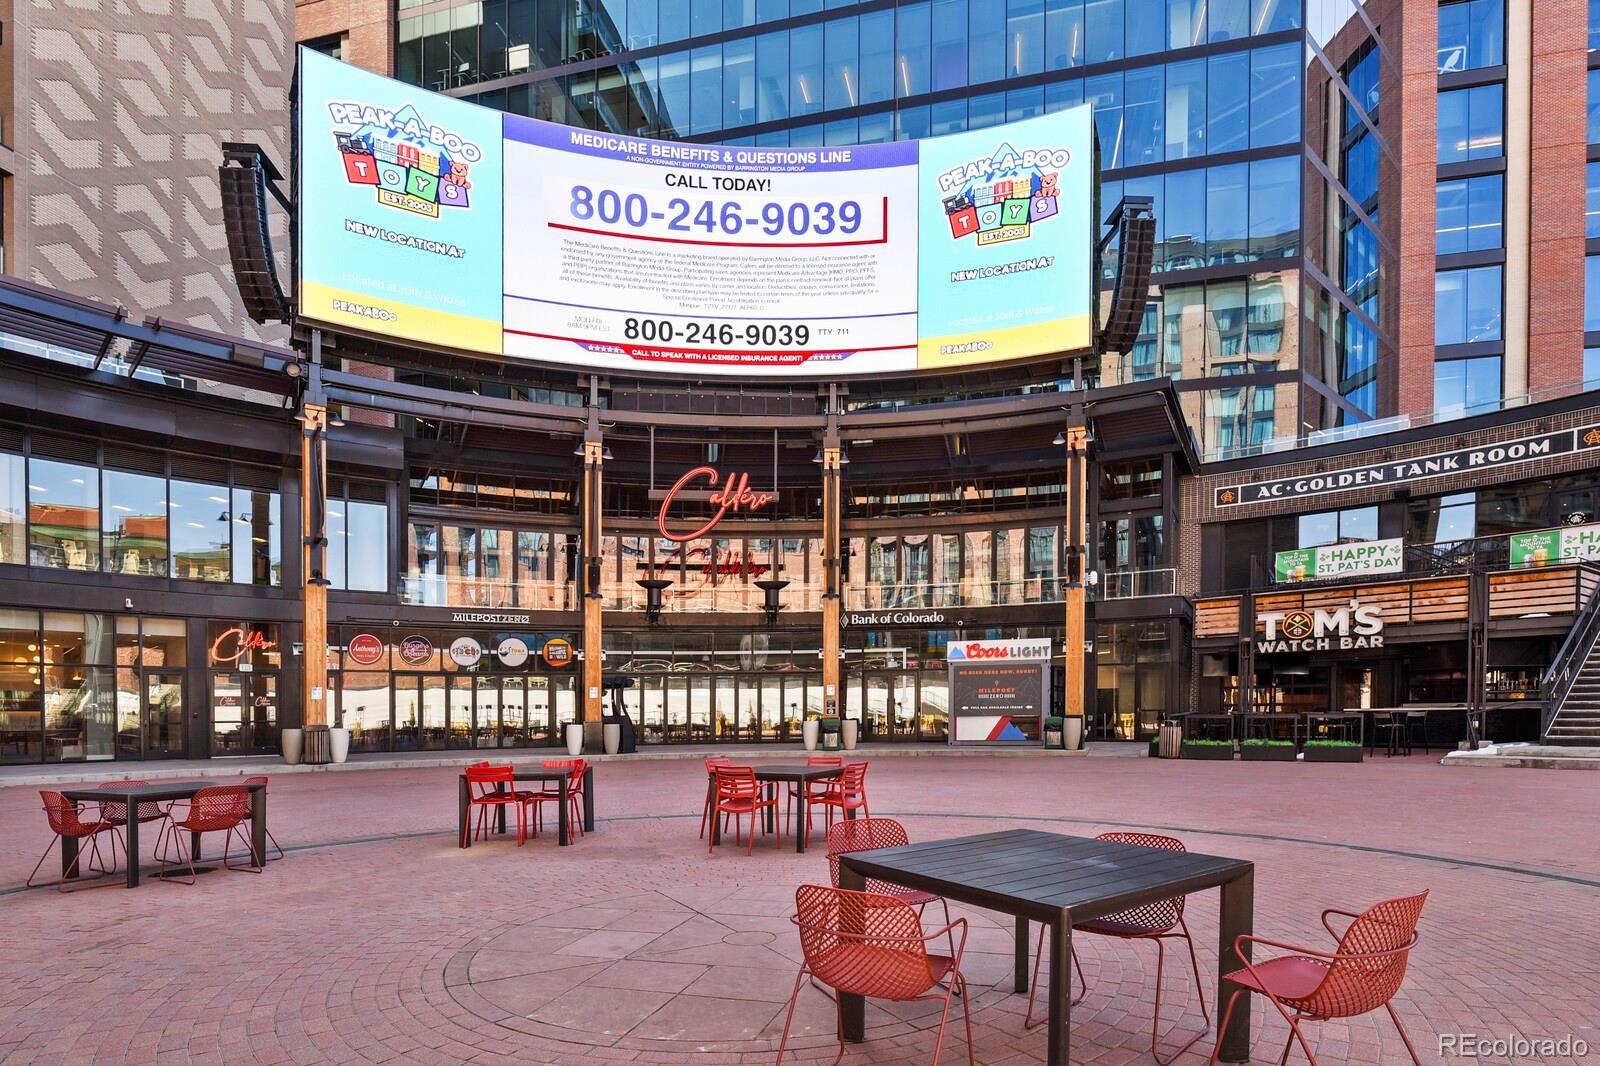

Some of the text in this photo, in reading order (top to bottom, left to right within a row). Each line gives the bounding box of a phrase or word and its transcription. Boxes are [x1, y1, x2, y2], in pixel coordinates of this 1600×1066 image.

[328, 103, 481, 162] PEAK-A-BOO
[571, 132, 852, 165] MEDICARE BENEFITS & QUESTIONS LINE
[631, 156, 681, 167] NON-GOVERNMENT
[938, 149, 1070, 193] PEAK-A-BOO
[665, 173, 771, 192] CALL TODAY!
[383, 193, 433, 213] EST. 2003
[569, 185, 862, 236] 800-246-9039
[345, 218, 379, 239] NEW
[379, 229, 447, 256] LOCATION
[982, 231, 1001, 242] EST.
[951, 269, 979, 283] NEW
[978, 258, 1038, 279] LOCATION
[624, 317, 810, 346] 800-246-9039
[818, 328, 835, 336] TTY:
[631, 349, 650, 357] CALL
[661, 351, 684, 359] SPEAK
[1294, 468, 1385, 493] GOLDEN
[1393, 455, 1459, 478] TANK
[1468, 439, 1551, 466] ROOM
[1331, 544, 1388, 562] HAPPY
[1563, 546, 1583, 557] ST.
[1318, 556, 1401, 573] ST. PAT'S DAY
[851, 611, 944, 625] Bank of Colorado
[1257, 598, 1384, 641] TOM'S
[966, 643, 1050, 659] Coors LIGHT
[1257, 635, 1384, 654] WATCH BAR
